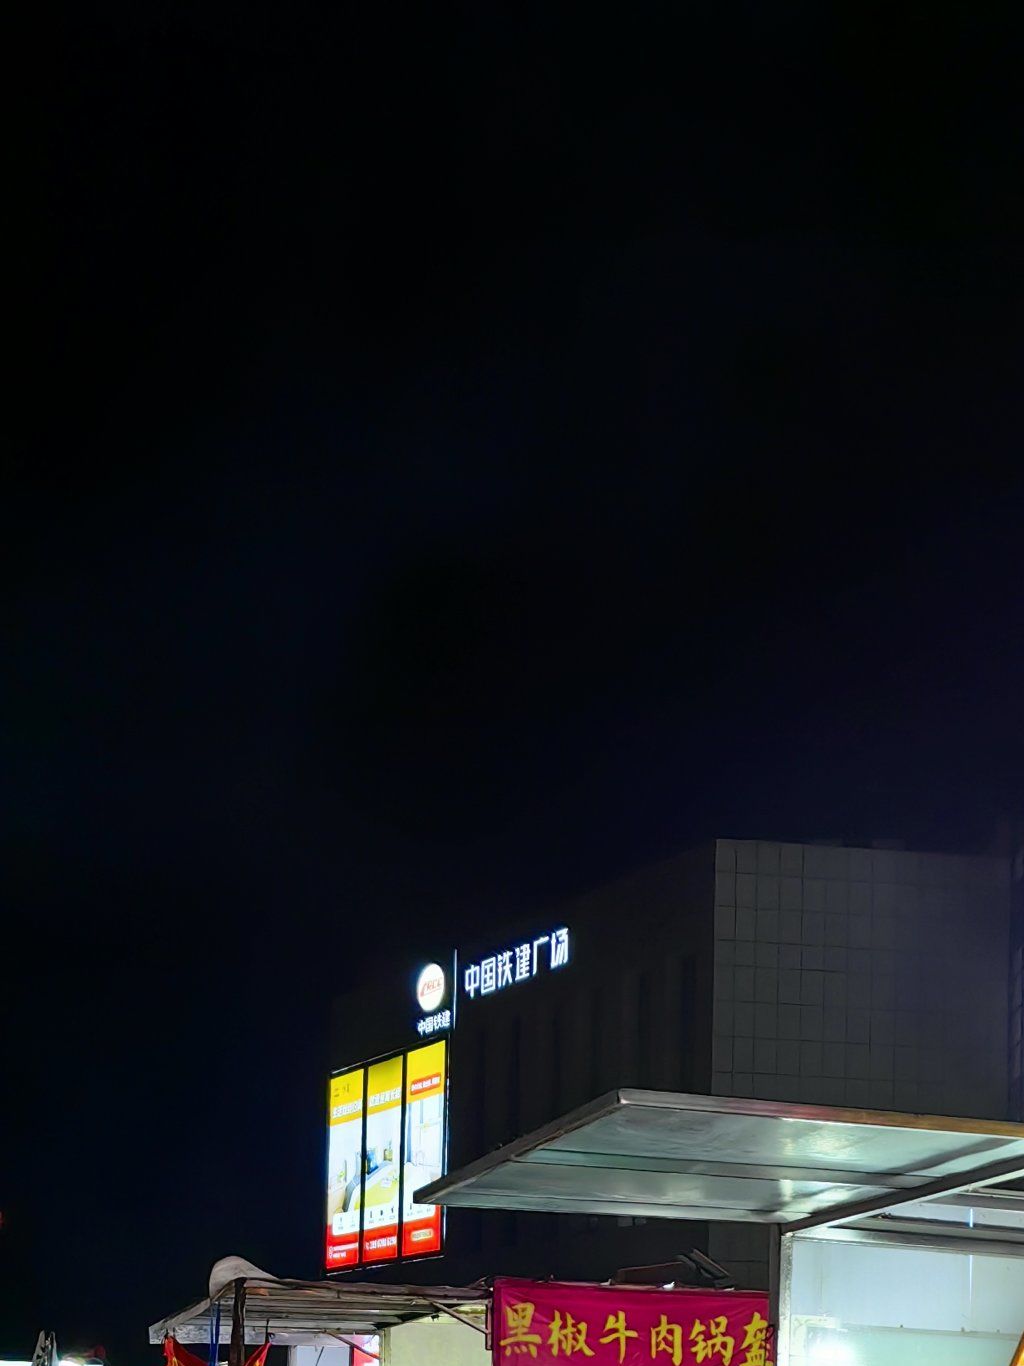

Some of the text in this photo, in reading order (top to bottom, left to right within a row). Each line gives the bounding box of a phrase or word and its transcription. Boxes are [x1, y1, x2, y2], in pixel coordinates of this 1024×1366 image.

[464, 926, 569, 1000] 中国铁建广场
[417, 1010, 451, 1036] 中国铁建
